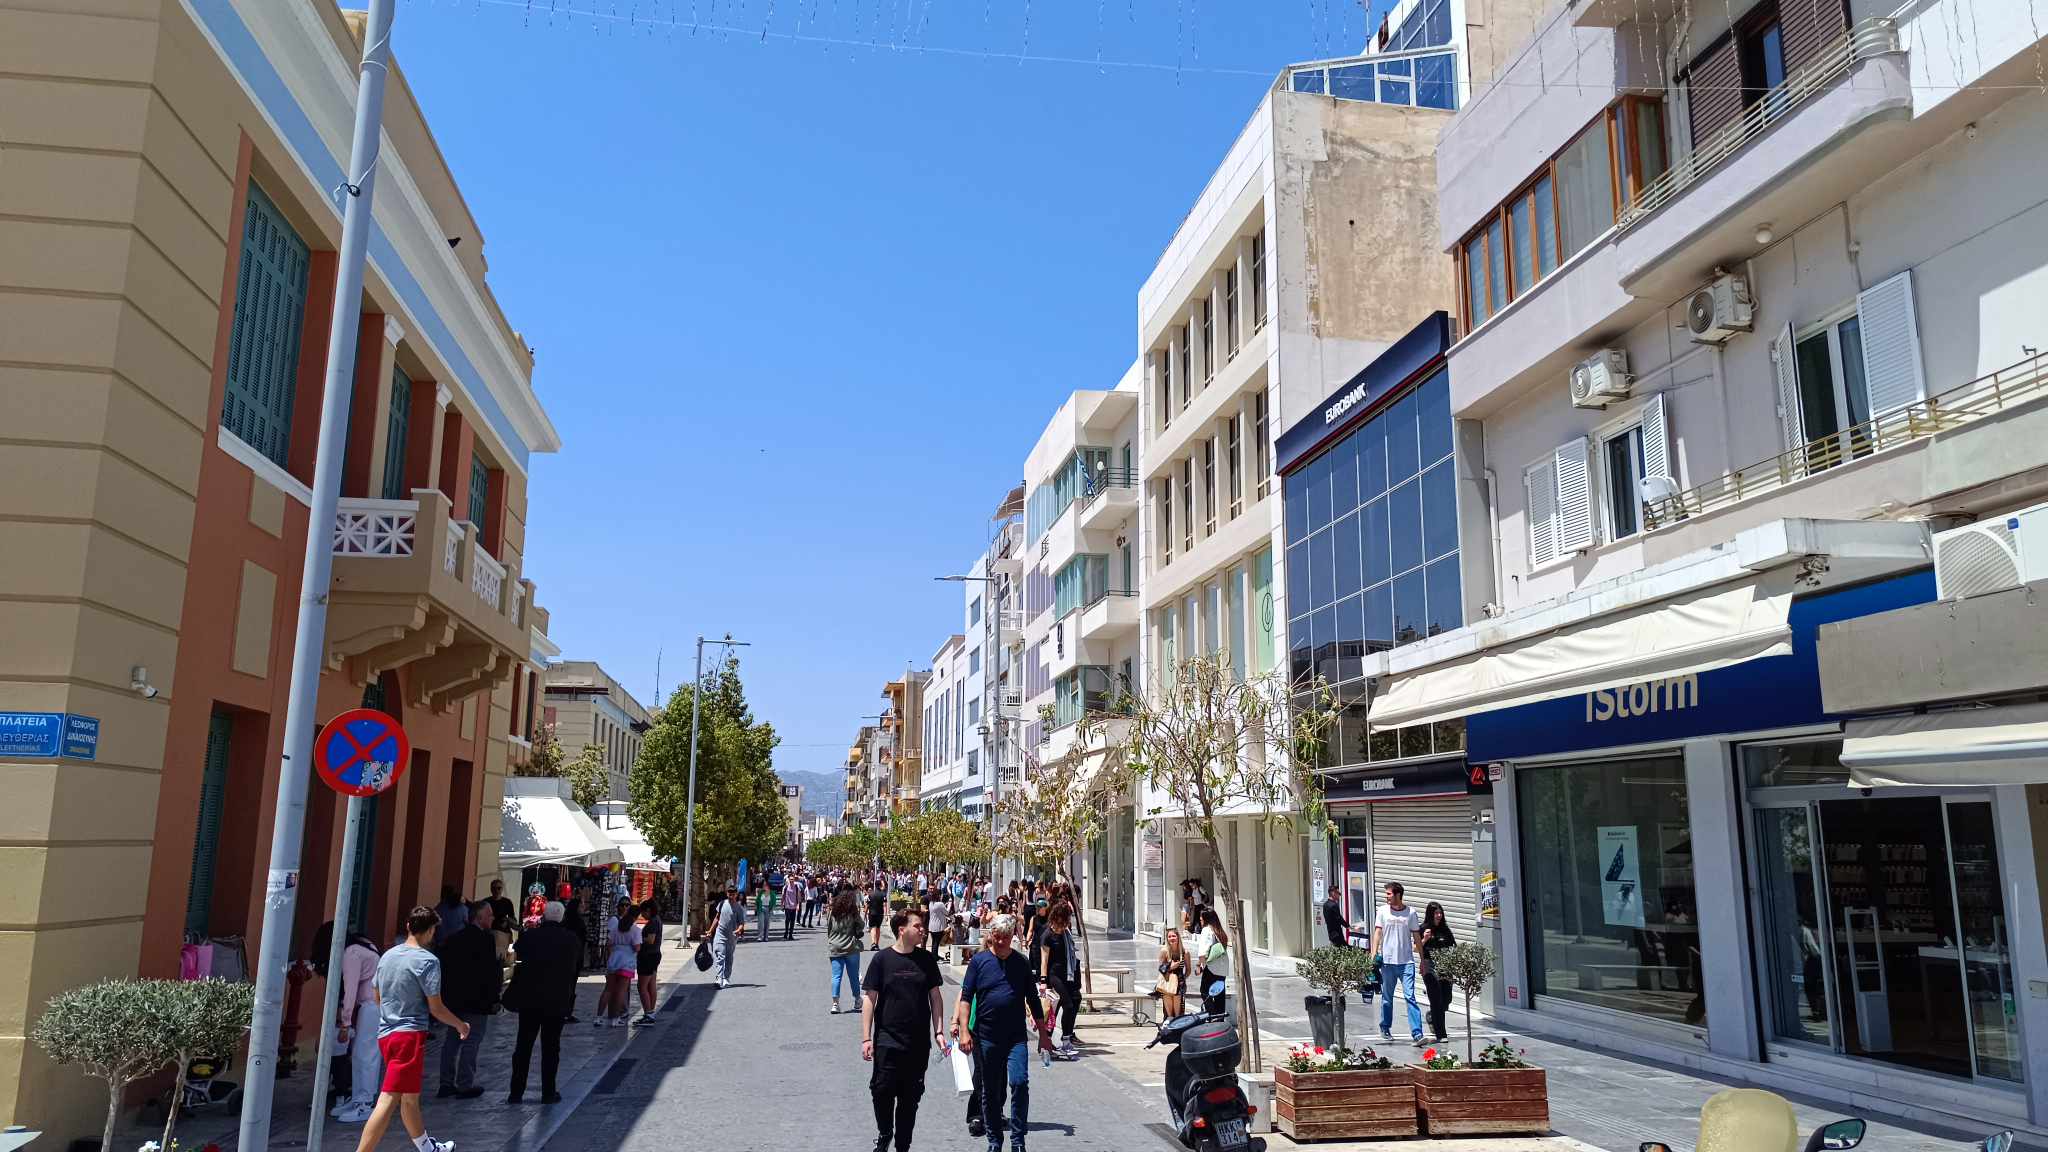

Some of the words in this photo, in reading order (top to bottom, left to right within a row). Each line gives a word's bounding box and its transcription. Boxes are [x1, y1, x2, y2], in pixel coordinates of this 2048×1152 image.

[1325, 382, 1366, 424] EUROBANK
[0, 716, 47, 726] ΠΛΑΤΕΙΑ
[1362, 777, 1395, 791] EUROBANK
